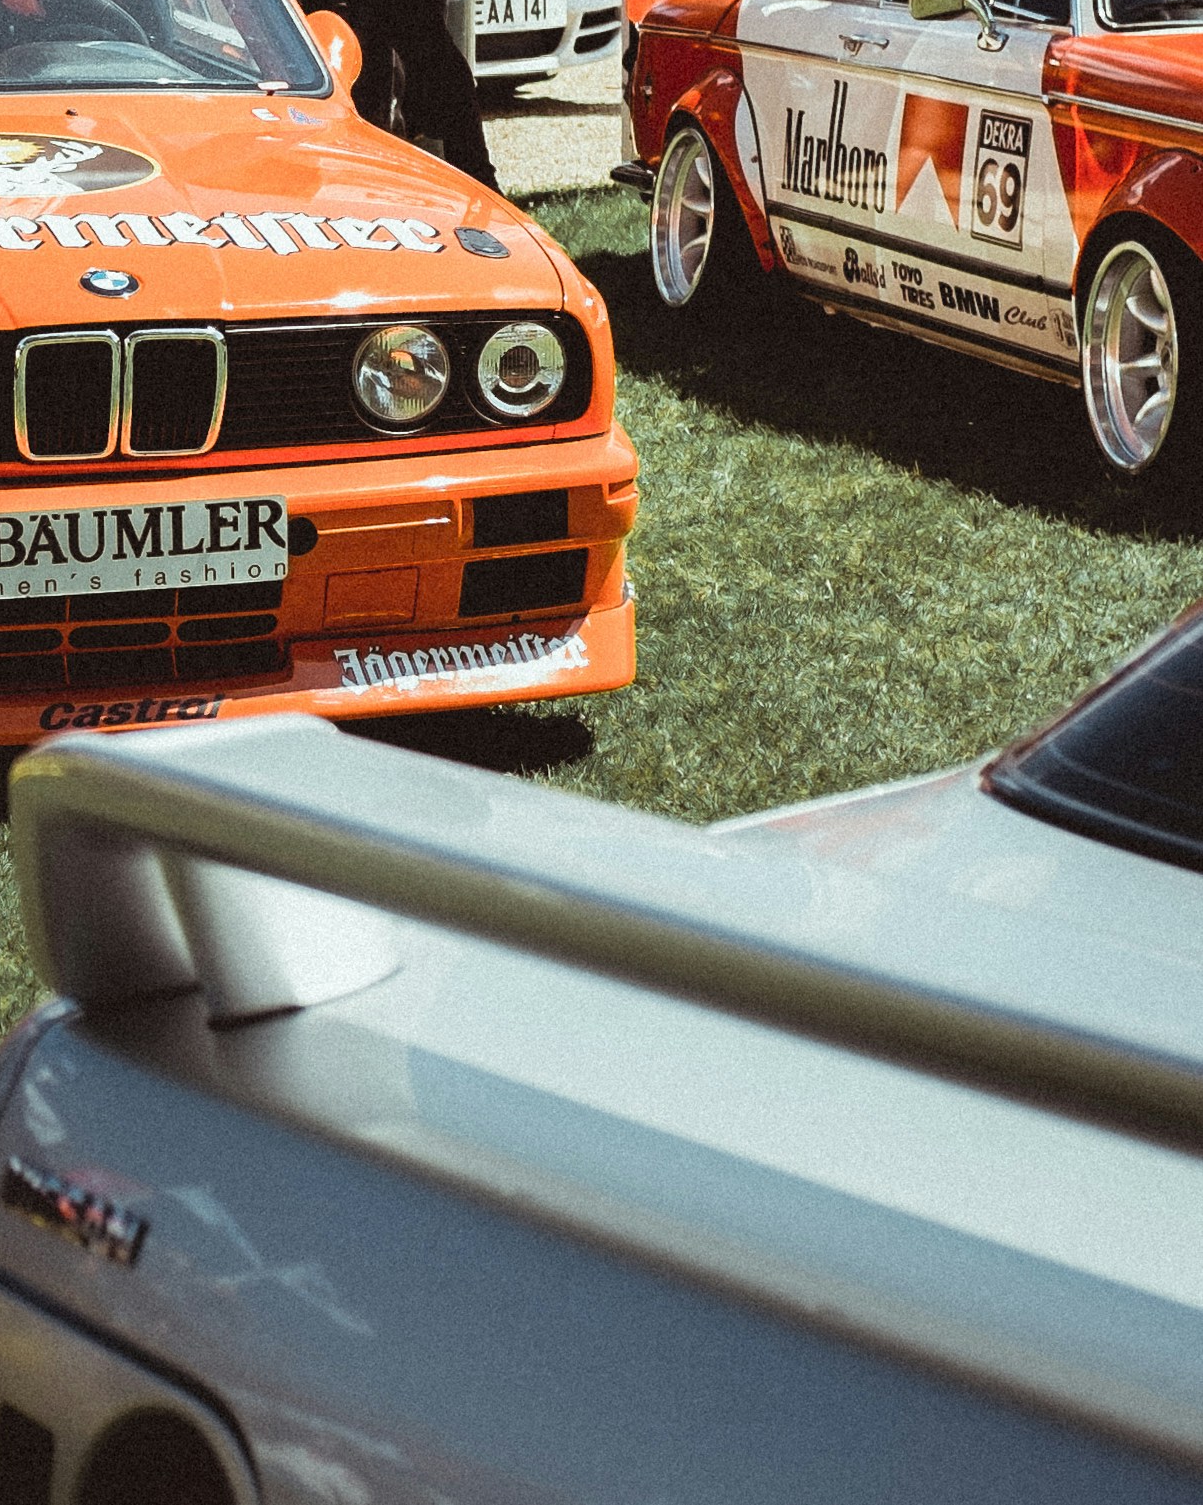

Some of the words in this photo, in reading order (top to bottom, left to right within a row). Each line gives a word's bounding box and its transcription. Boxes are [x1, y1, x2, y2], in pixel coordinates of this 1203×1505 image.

[780, 78, 888, 214] Marlboro
[982, 117, 1025, 152] DEKRA
[976, 157, 1022, 233] 69
[891, 260, 923, 286] TOYO
[899, 283, 936, 311] TIRES
[938, 281, 1001, 324] BMW
[1003, 305, 1048, 331] Club
[134, 561, 286, 587] fashion
[39, 692, 227, 731] Castrol
